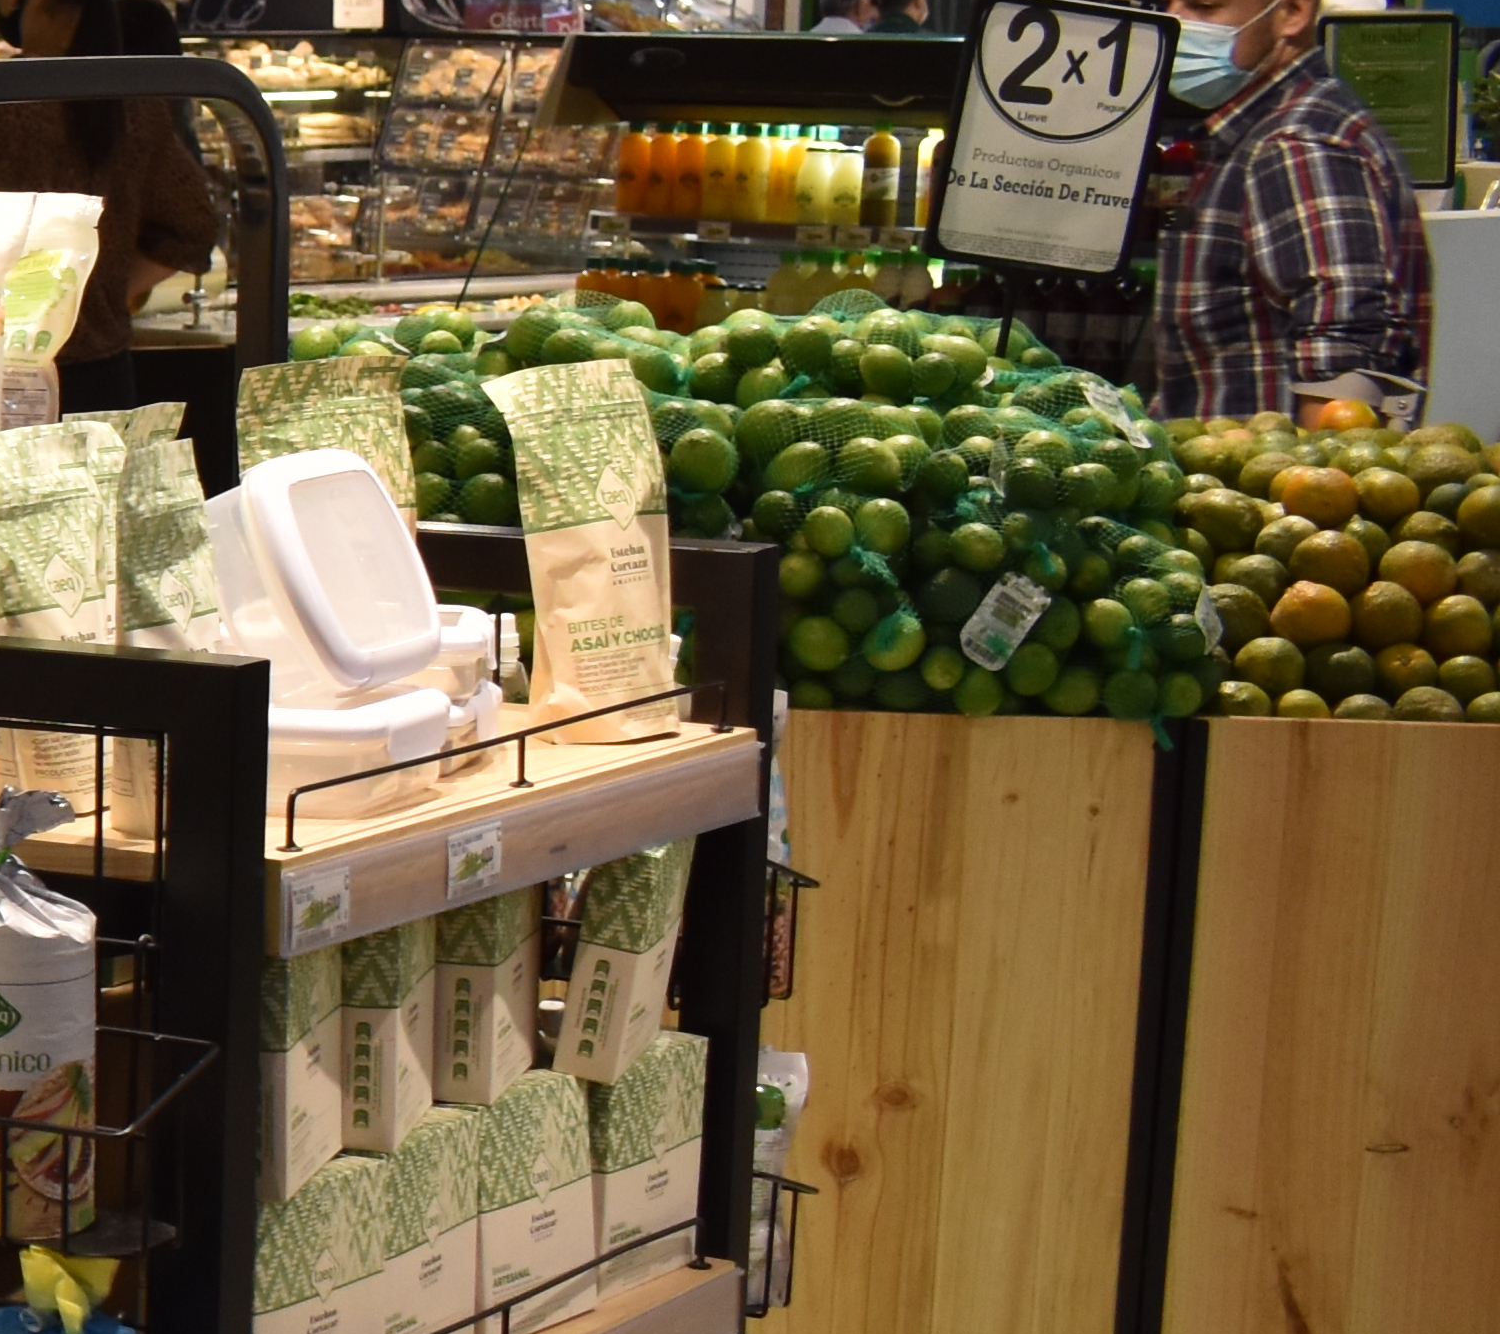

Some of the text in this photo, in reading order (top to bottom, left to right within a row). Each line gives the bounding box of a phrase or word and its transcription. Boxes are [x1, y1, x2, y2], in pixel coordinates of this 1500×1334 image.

[1016, 110, 1048, 123] Lleve
[972, 147, 1044, 170] Productos
[946, 169, 966, 187] De
[970, 171, 989, 191] La
[992, 174, 1054, 199] Sección
[1057, 183, 1080, 203] De
[567, 615, 624, 635] BITES DE
[570, 630, 622, 653] ASAÍ Y
